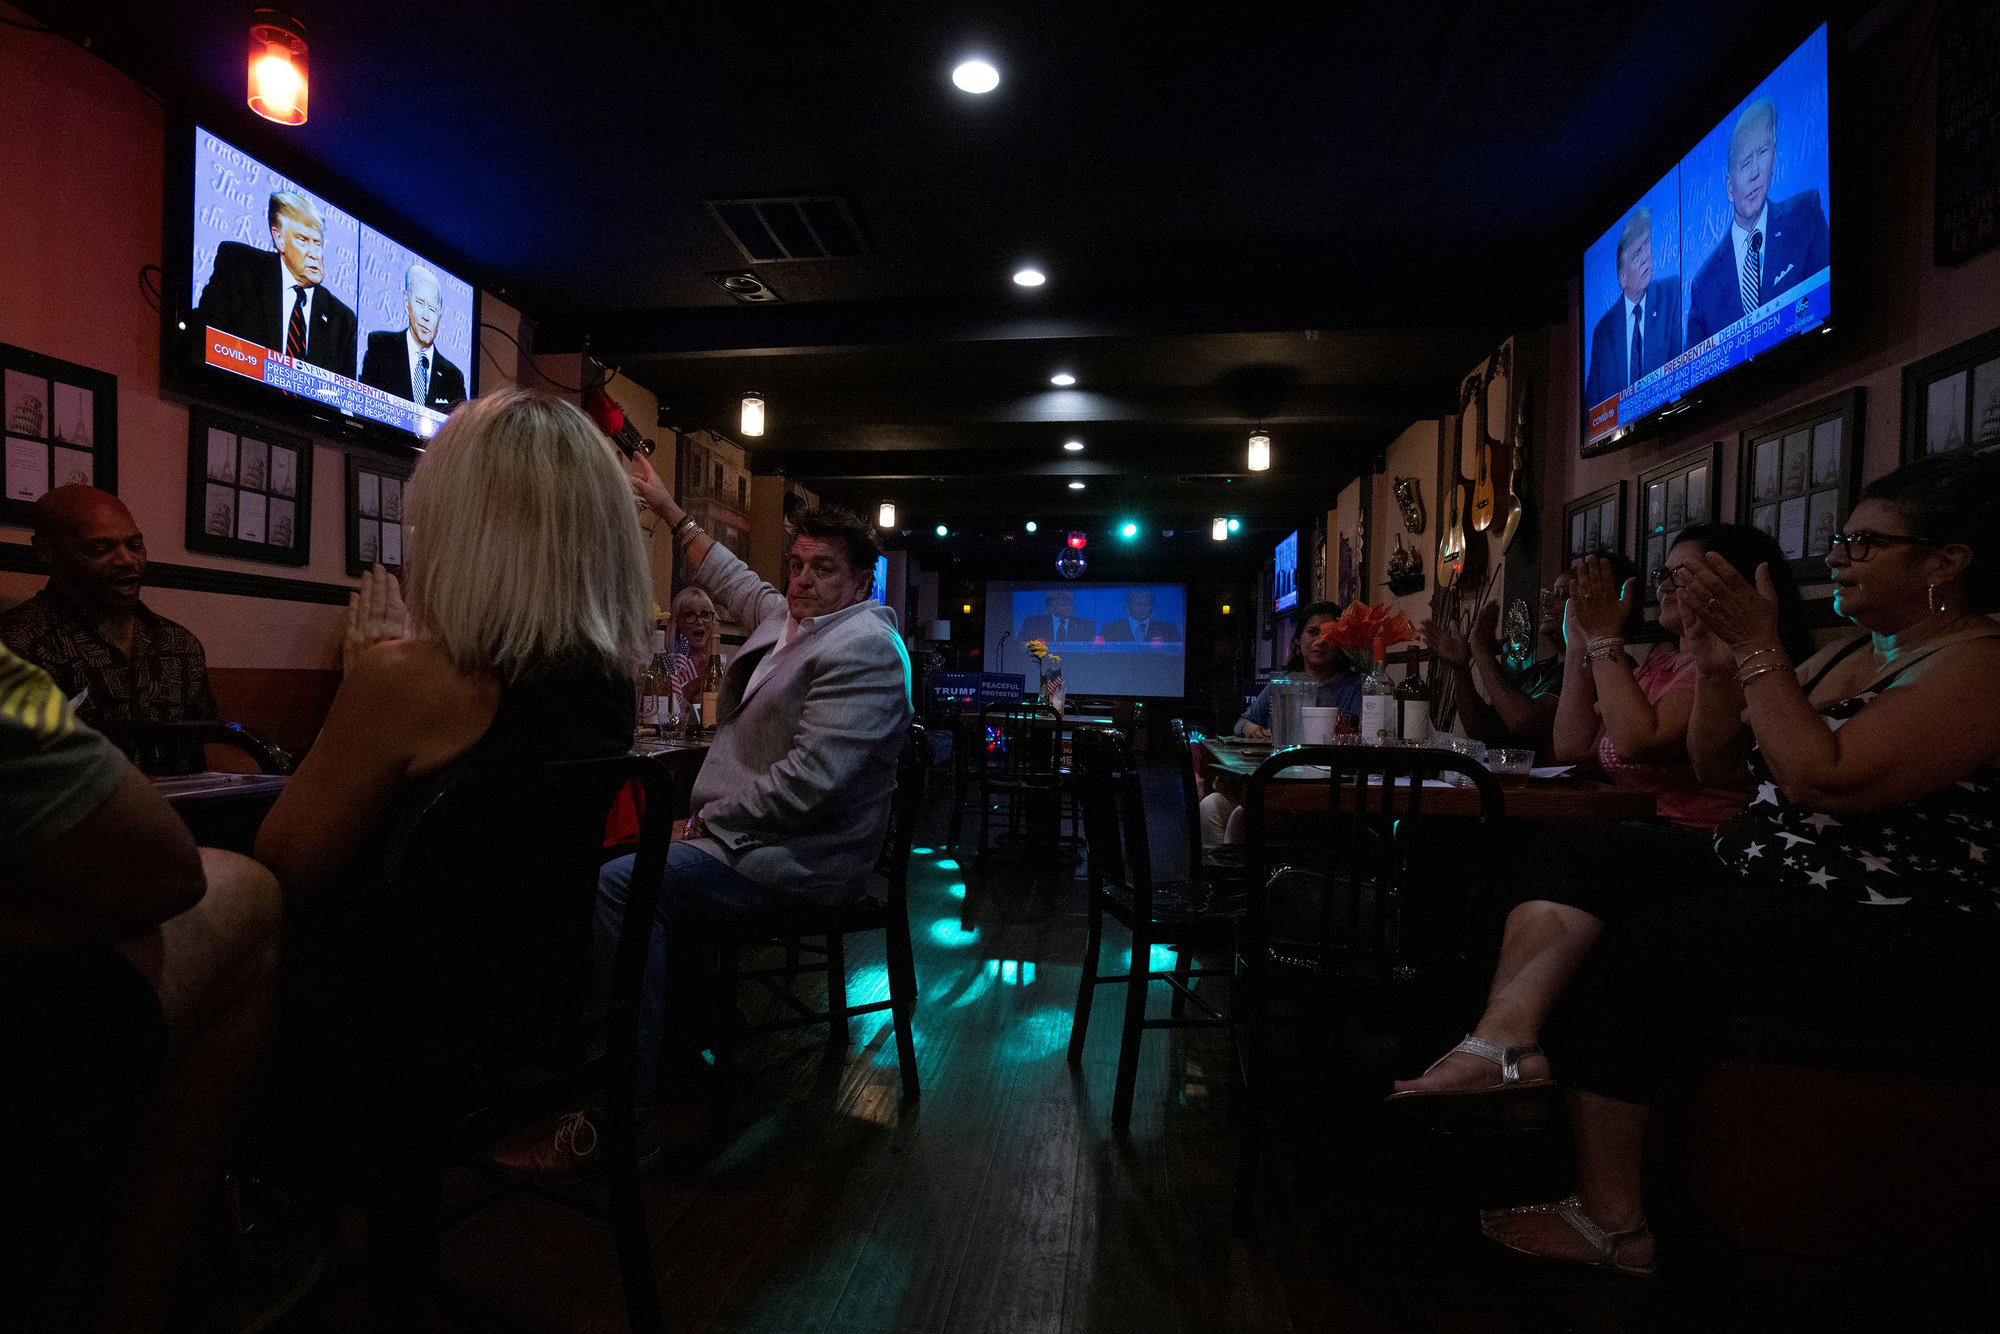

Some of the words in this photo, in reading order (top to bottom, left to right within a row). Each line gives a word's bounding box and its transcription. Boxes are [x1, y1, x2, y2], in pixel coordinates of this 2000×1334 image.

[204, 136, 260, 184] among
[212, 162, 254, 210] That
[200, 204, 229, 234] the
[1795, 297, 1809, 314] abc
[213, 343, 259, 366] COVID-19
[1620, 387, 1633, 401] LIVE
[1640, 371, 1660, 386] NEWS
[1663, 337, 1716, 375] PRESIDENTIAL
[1719, 314, 1753, 341] DEBATE
[1620, 389, 1651, 412] PRESIDENT
[1652, 378, 1674, 395] TRUMP
[1675, 367, 1689, 383] AND
[1691, 348, 1721, 372] FORMER
[1722, 341, 1734, 355] VP
[1736, 334, 1751, 349] JOE
[1754, 313, 1780, 339] BIDEN
[267, 349, 291, 367] LIVE
[303, 363, 329, 379] NEWS
[334, 375, 390, 403] PRESIDENTIAL
[392, 398, 421, 414] DEBATE
[267, 362, 315, 387] PRESIDENT
[318, 380, 345, 396] TRUMP
[347, 391, 364, 403] AND
[366, 395, 396, 414] FORMER
[396, 408, 405, 418] VP
[406, 411, 420, 423] JOE
[267, 373, 302, 393] DEBATE
[304, 385, 363, 413] CORONAVIRUS
[364, 406, 402, 426] RESPONSE
[1620, 405, 1641, 423] DEBATE
[1643, 382, 1690, 411] CORONAVIRUS
[1691, 356, 1730, 383] RESPONSE
[1592, 408, 1615, 427] COVID-19
[934, 687, 976, 695] TRUMP
[981, 681, 1020, 690] PEACEFUL
[981, 690, 1019, 698] PROTESTER
